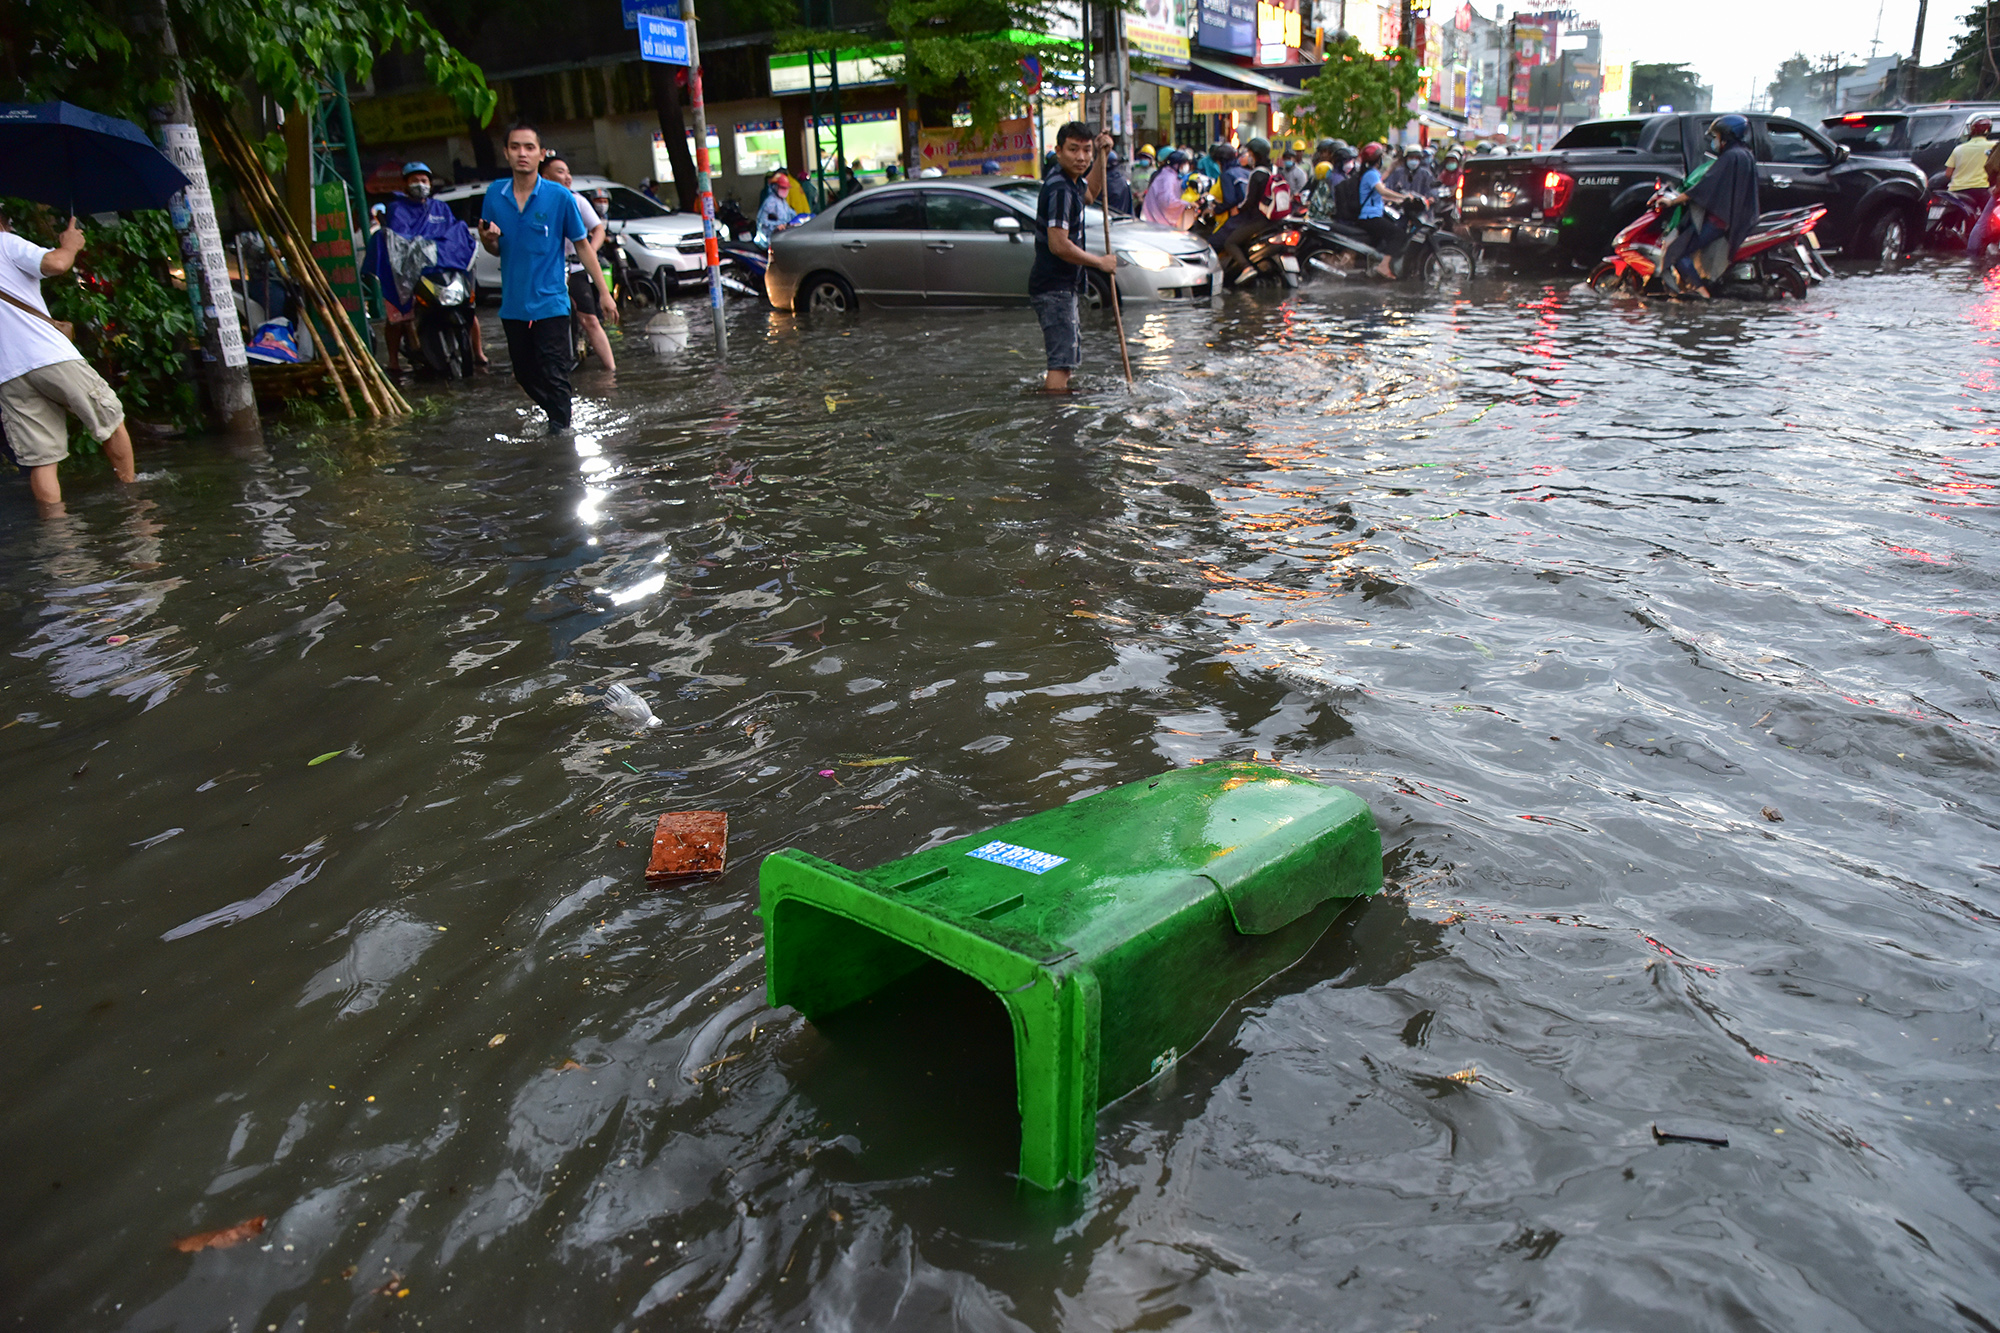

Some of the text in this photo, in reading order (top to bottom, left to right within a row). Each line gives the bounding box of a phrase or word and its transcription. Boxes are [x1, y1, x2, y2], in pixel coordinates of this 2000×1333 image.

[649, 22, 678, 38] ĐƯỜNG
[643, 35, 687, 61] ĐỖ XUÂN HỢP
[1578, 176, 1620, 186] CALIBRE
